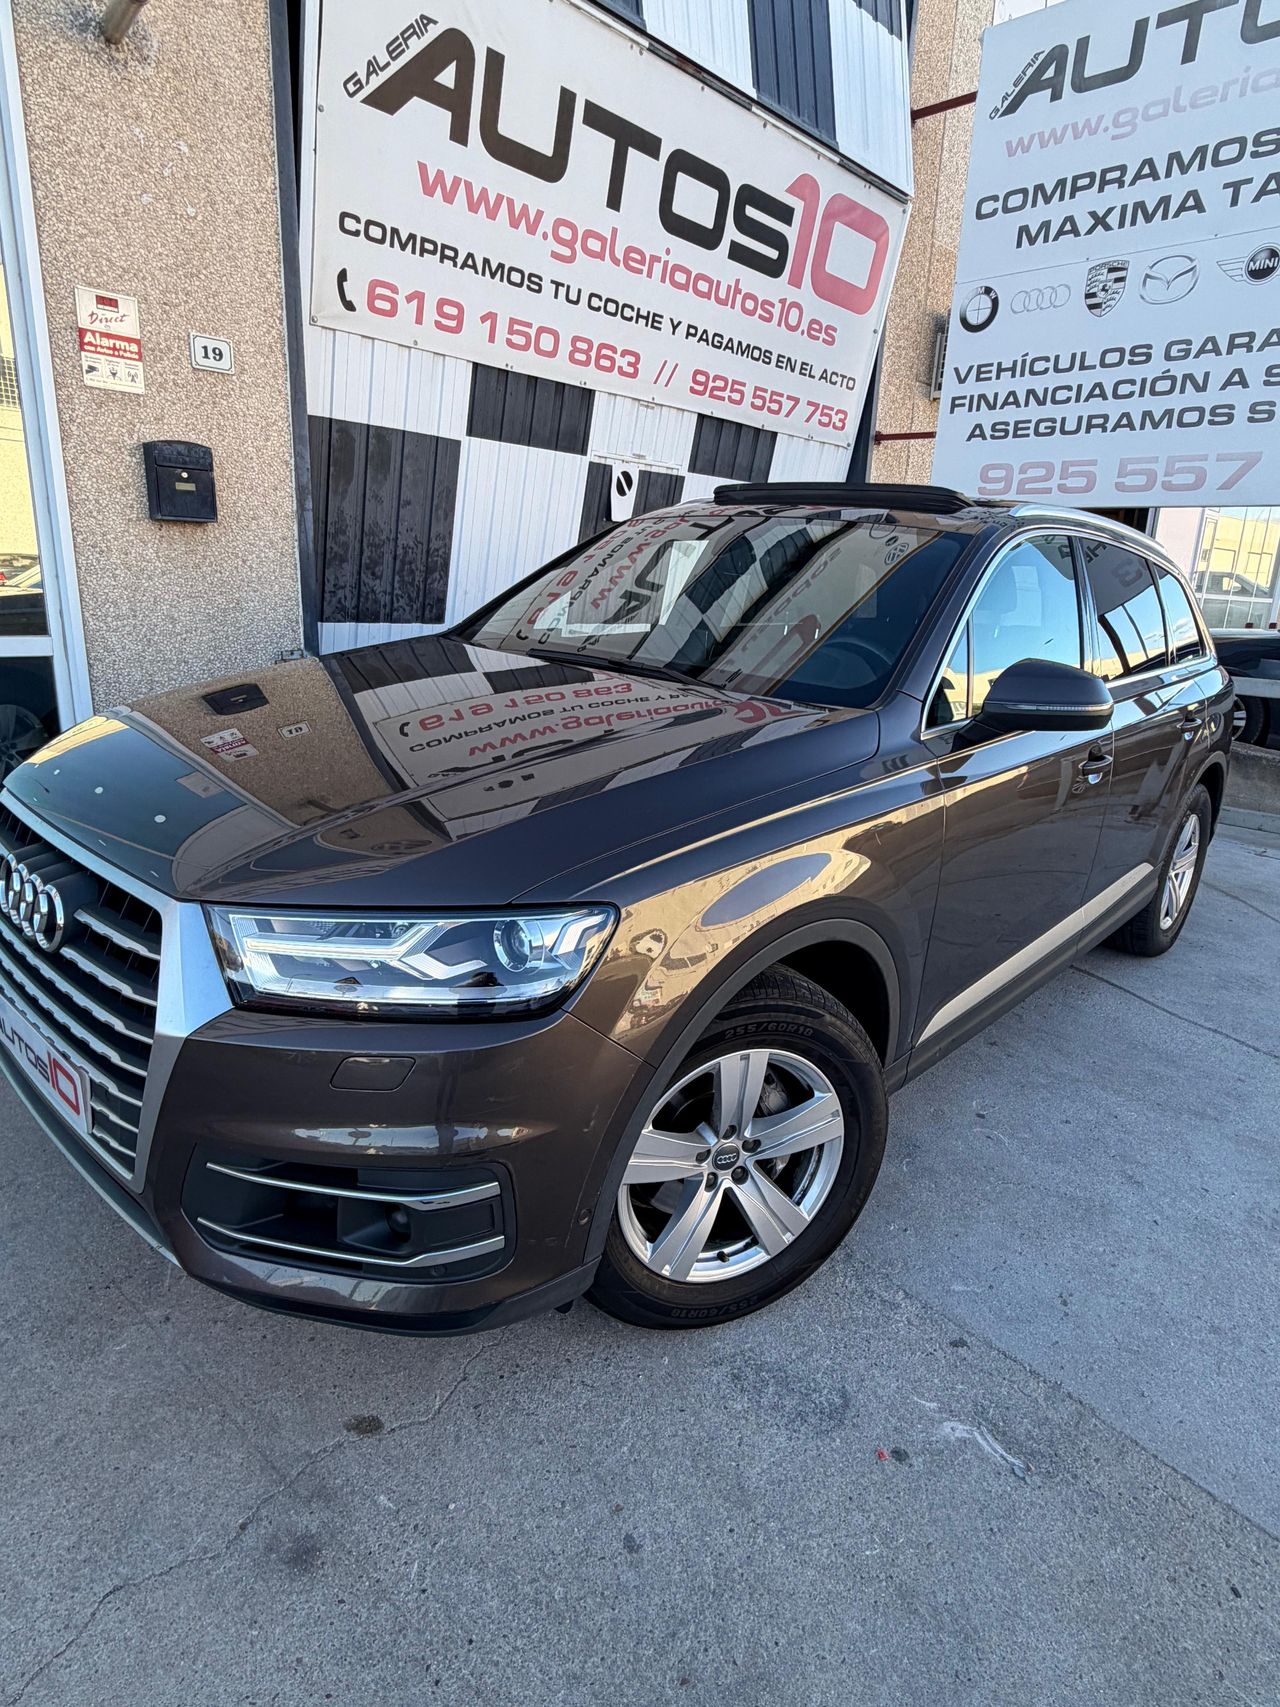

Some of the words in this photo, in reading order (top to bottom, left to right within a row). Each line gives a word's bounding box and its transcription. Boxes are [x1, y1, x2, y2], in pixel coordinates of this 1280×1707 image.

[342, 14, 438, 99] GALERIA
[989, 49, 1046, 121] GALERIA
[359, 27, 890, 316] AUTOS10
[975, 127, 1280, 221] COMPRAMOS
[1015, 189, 1209, 249] MAXIMA
[417, 160, 839, 348] www.galeriaautos10.es
[1249, 257, 1278, 271] MINI
[338, 211, 543, 294] COMPRAMOS
[550, 280, 582, 306] TU
[587, 292, 664, 333] COCHE
[669, 317, 683, 337] Y
[685, 323, 773, 366] PAGAMOS
[775, 353, 798, 375] EN
[798, 361, 816, 379] EL
[818, 368, 856, 391] ACTO
[83, 331, 139, 354] Alarma
[201, 345, 223, 362] 19
[366, 279, 465, 336] 619
[479, 311, 560, 360] 150
[568, 335, 641, 380] 863
[689, 368, 747, 407] 925
[750, 379, 802, 418] 557
[805, 401, 848, 432] 753
[954, 344, 1152, 385] VEHÍCULOS
[950, 368, 1210, 415] FINANCIACIÓN
[1219, 367, 1250, 392] A
[966, 403, 1236, 442] ASEGURAMOS
[977, 460, 1098, 497] 925
[1114, 451, 1264, 494] 557
